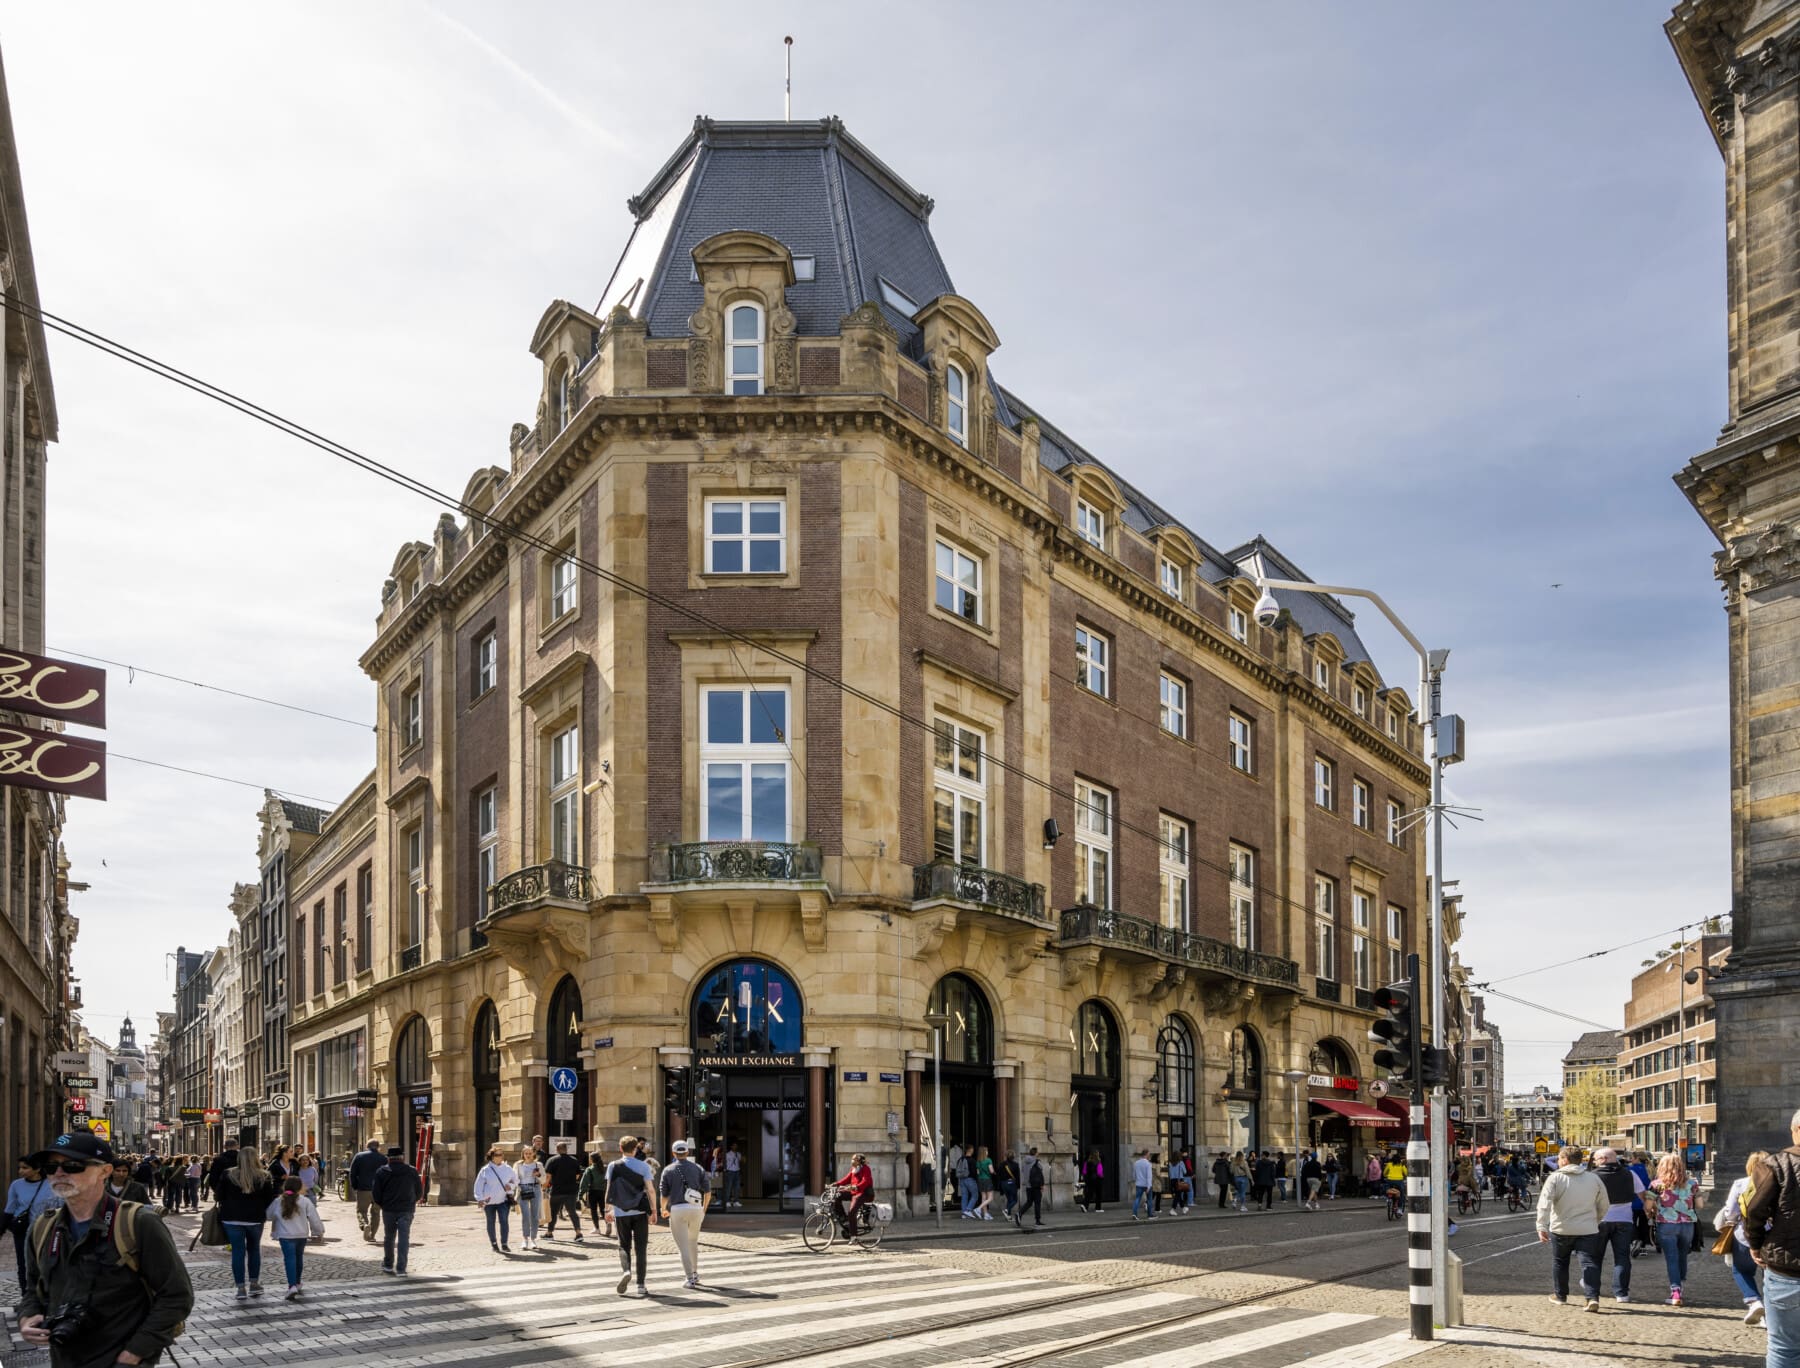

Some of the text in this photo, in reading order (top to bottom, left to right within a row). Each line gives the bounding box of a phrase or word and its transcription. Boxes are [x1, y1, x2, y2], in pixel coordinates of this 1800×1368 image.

[568, 1011, 579, 1036] A
[699, 1056, 796, 1066] ARMANI EXCHANGE
[68, 1078, 94, 1087] snipes
